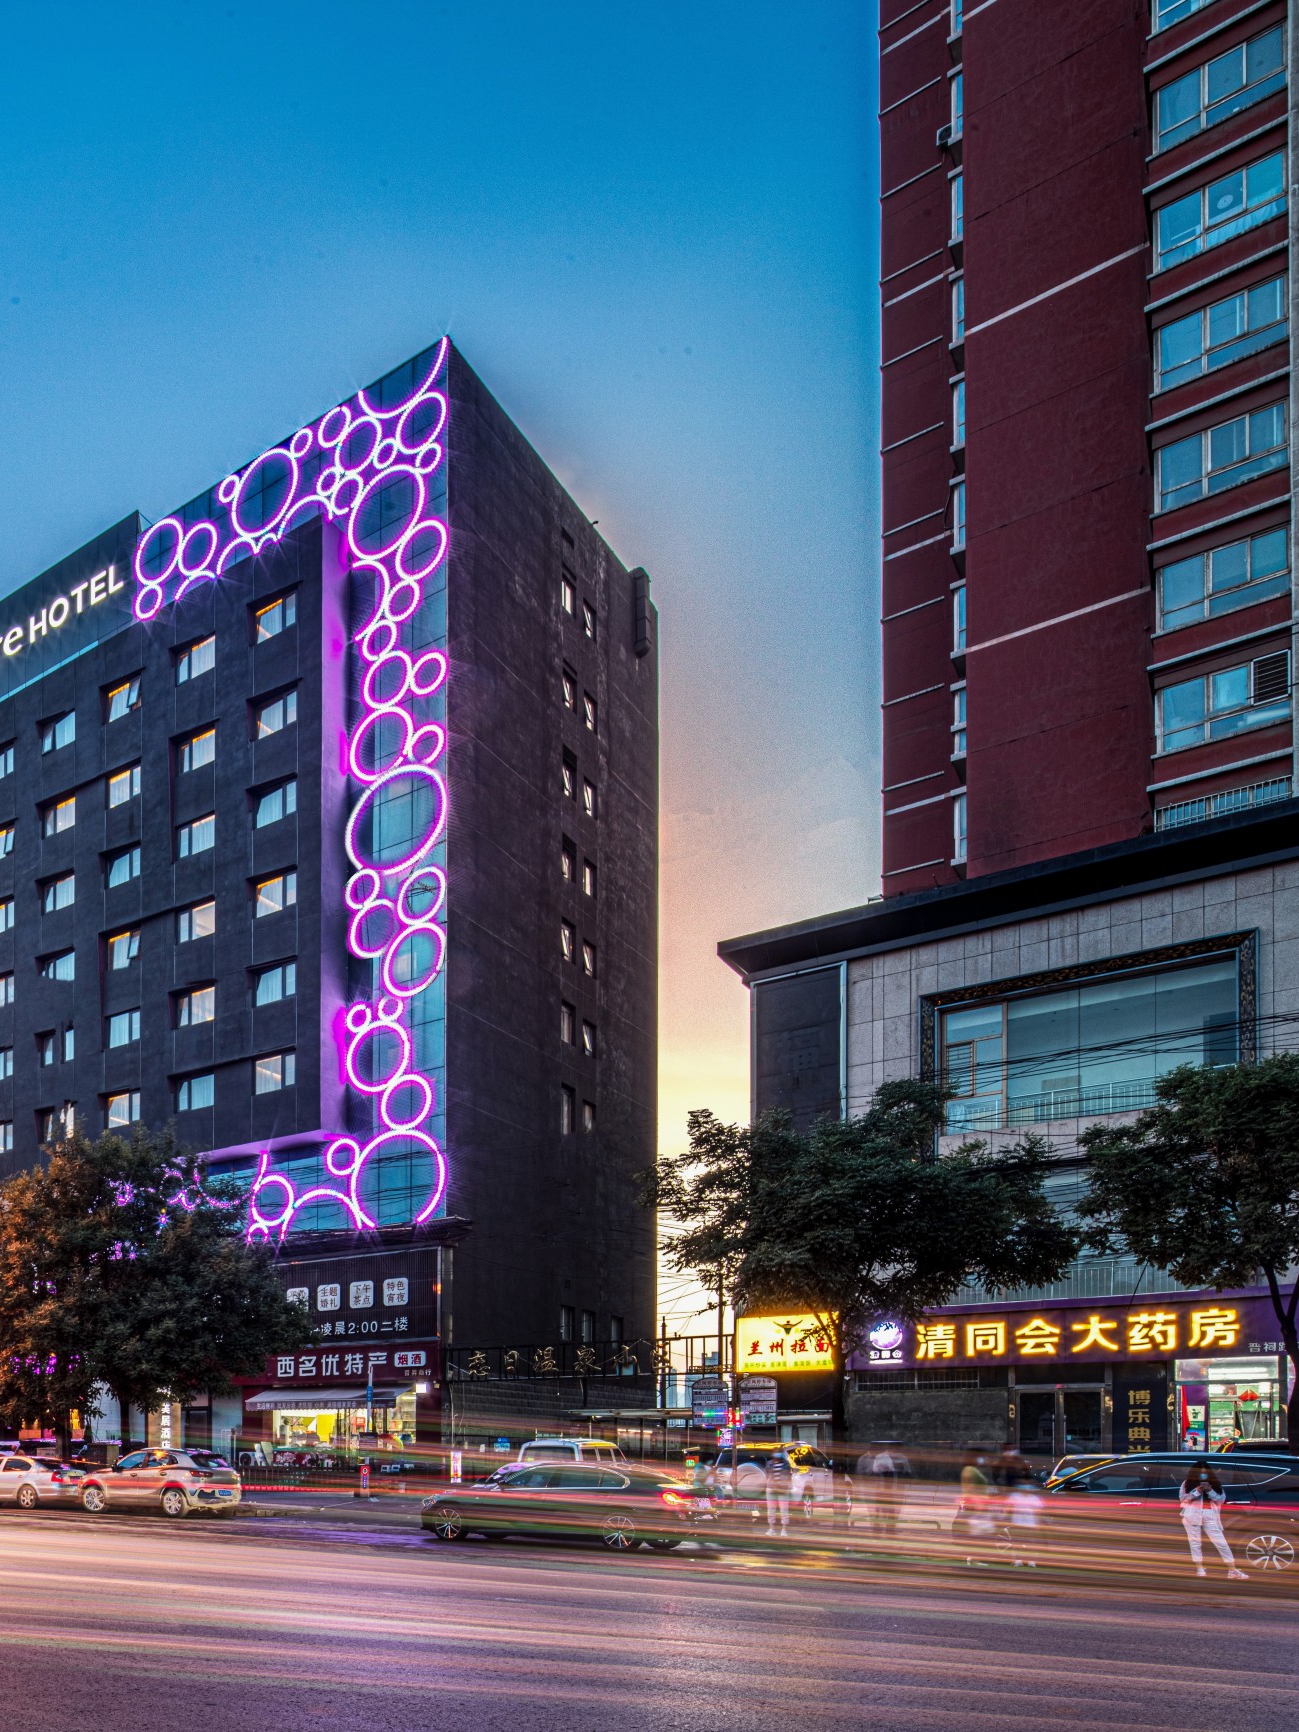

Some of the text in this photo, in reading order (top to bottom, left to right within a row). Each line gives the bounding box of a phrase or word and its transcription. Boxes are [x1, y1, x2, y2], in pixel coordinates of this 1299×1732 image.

[29, 564, 124, 643] HOTEL
[320, 1286, 338, 1297] 主题
[353, 1284, 371, 1295] 下午
[386, 1280, 405, 1291] 特色
[352, 1295, 371, 1306] 茶点
[386, 1292, 406, 1304] 宵夜
[915, 1308, 1241, 1360] 清同会大药房
[747, 1337, 831, 1357] 兰州拉面
[277, 1351, 388, 1378] 西名优特产
[397, 1353, 422, 1366] 烟酒
